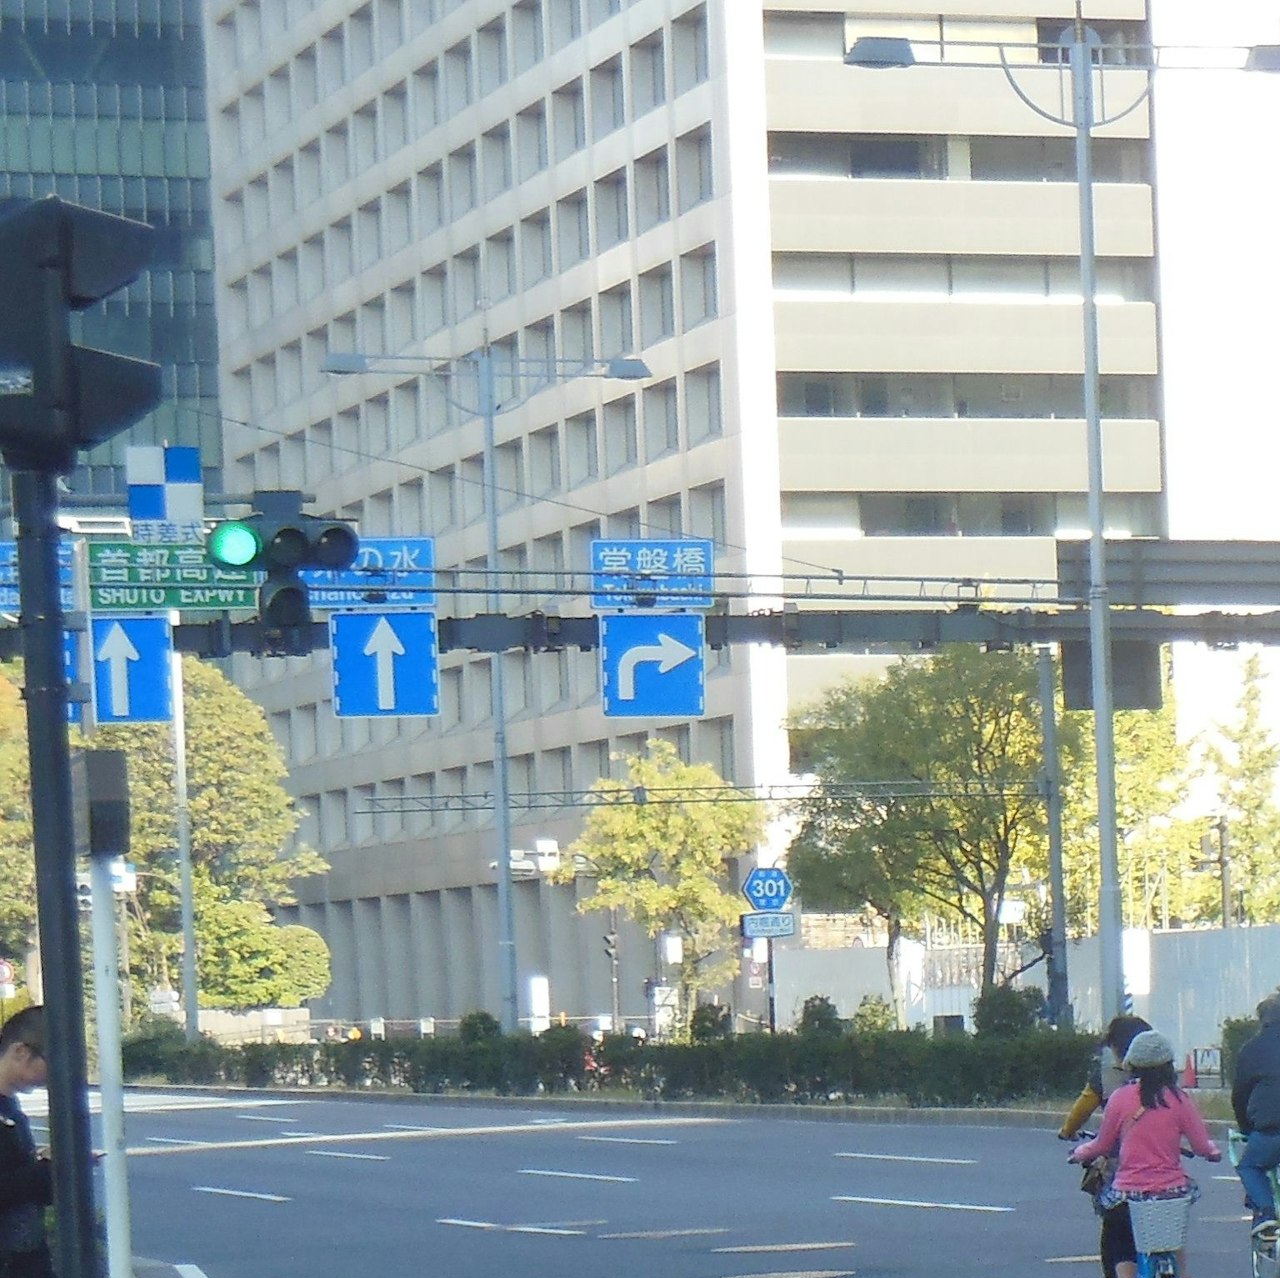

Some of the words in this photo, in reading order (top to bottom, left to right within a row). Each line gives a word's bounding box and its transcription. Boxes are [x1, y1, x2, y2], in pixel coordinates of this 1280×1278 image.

[133, 522, 205, 543] 時差式
[97, 548, 247, 582] 首都高
[100, 587, 165, 605] SHUTO
[752, 879, 786, 897] 301
